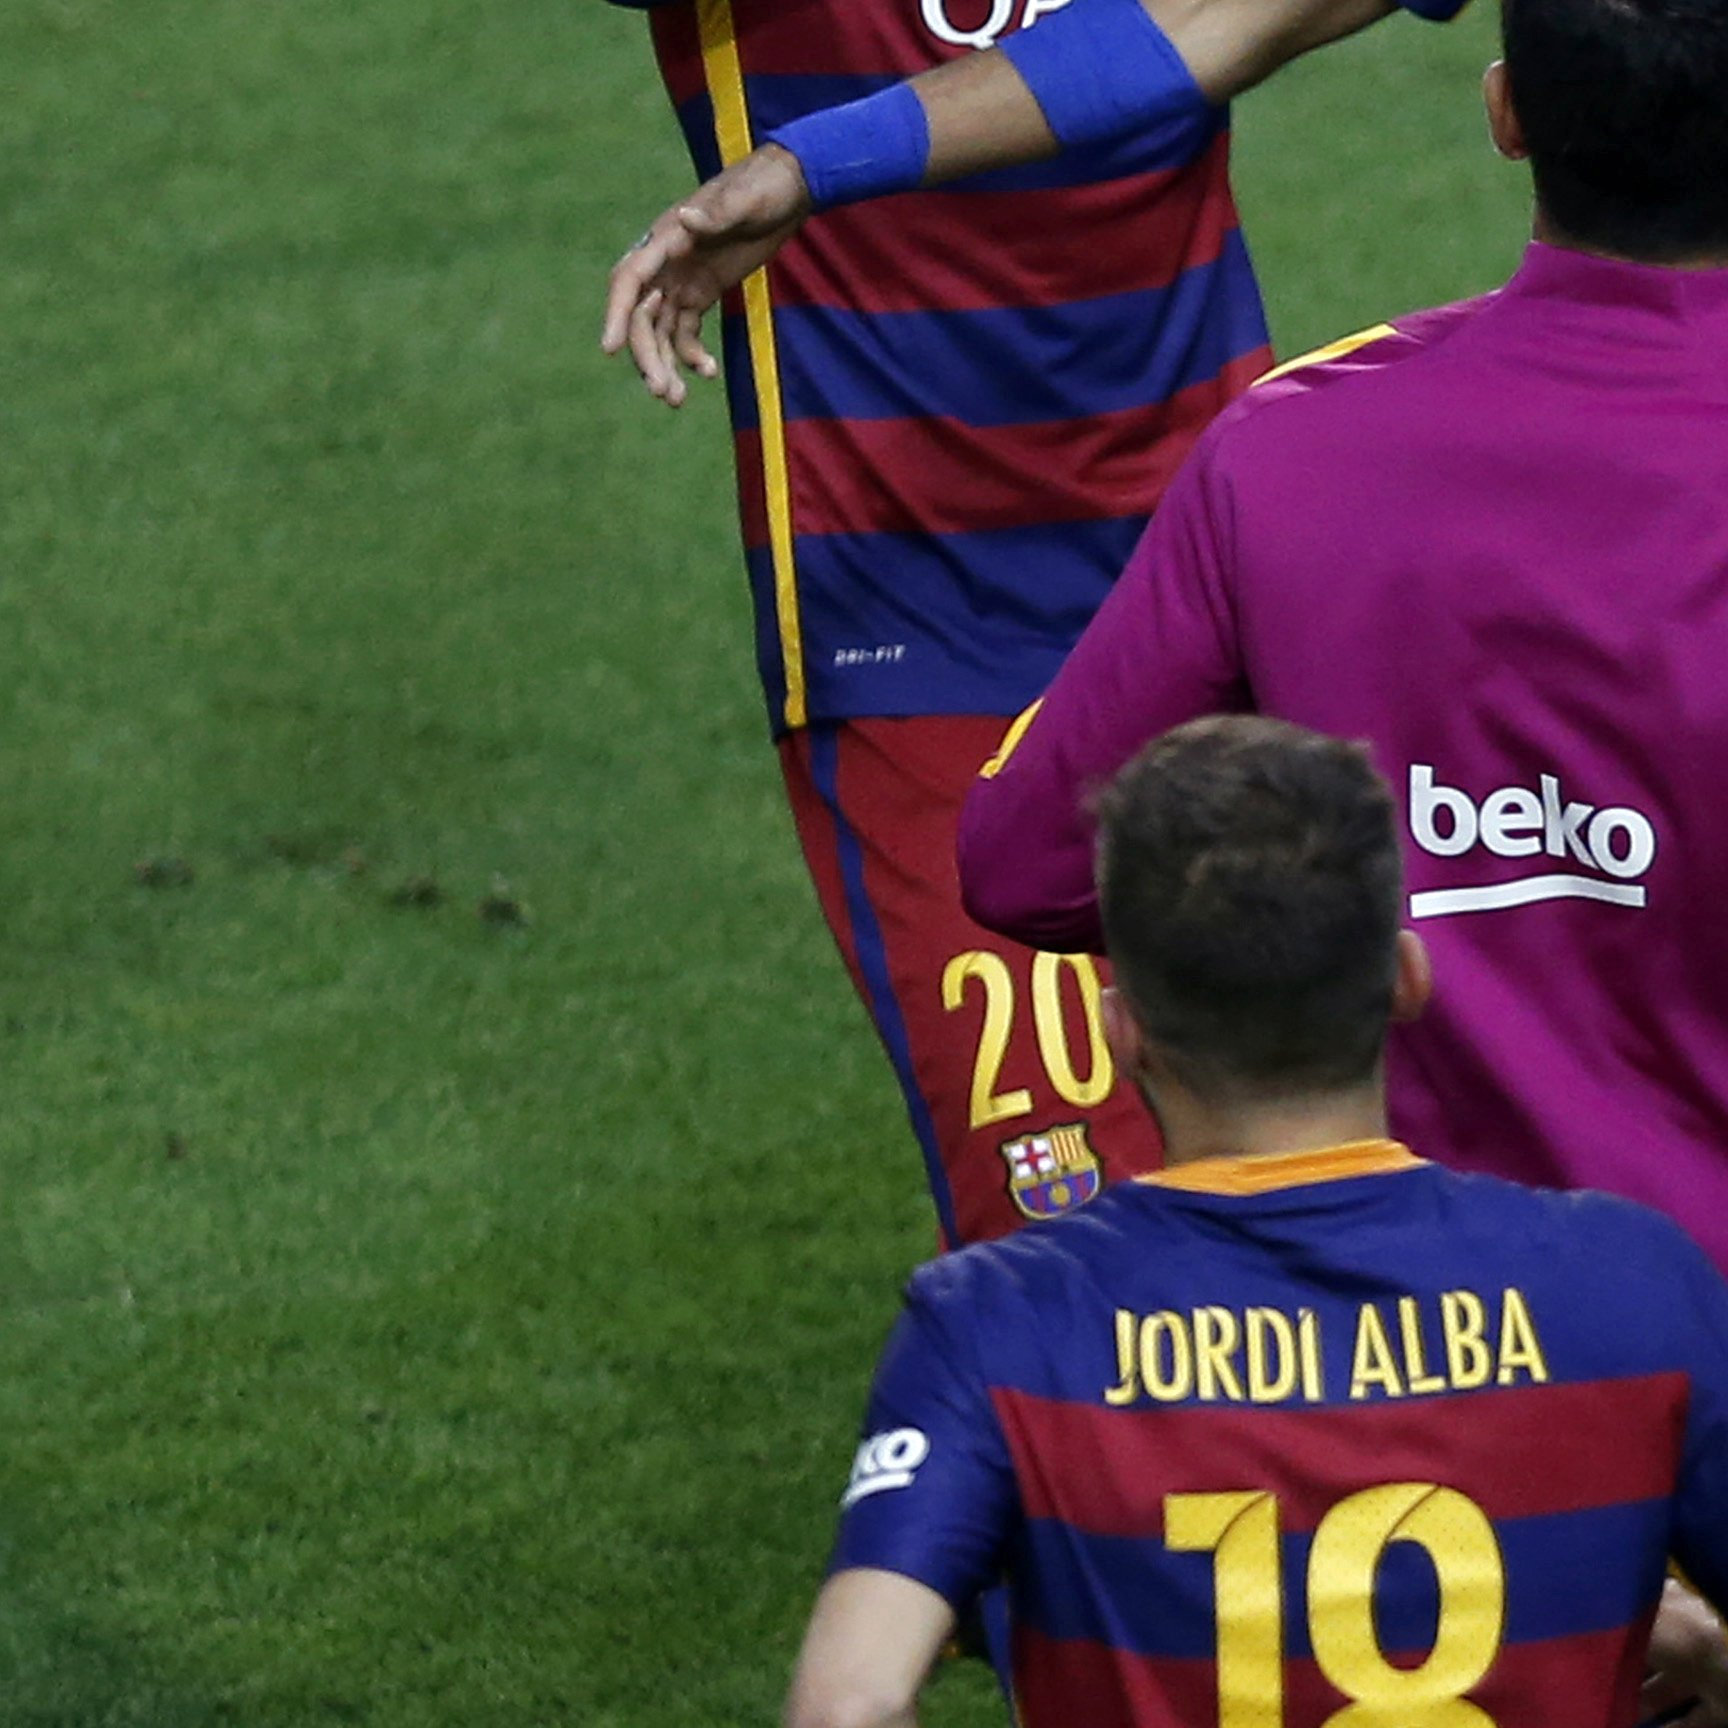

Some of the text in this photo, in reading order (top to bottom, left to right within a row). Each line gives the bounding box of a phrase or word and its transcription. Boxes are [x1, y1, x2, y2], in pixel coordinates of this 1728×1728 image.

[1409, 764, 1656, 878] beko
[941, 952, 1114, 1129] 20
[1104, 1287, 1549, 1405] JORDI ALBA
[1164, 1482, 1504, 1728] 18
